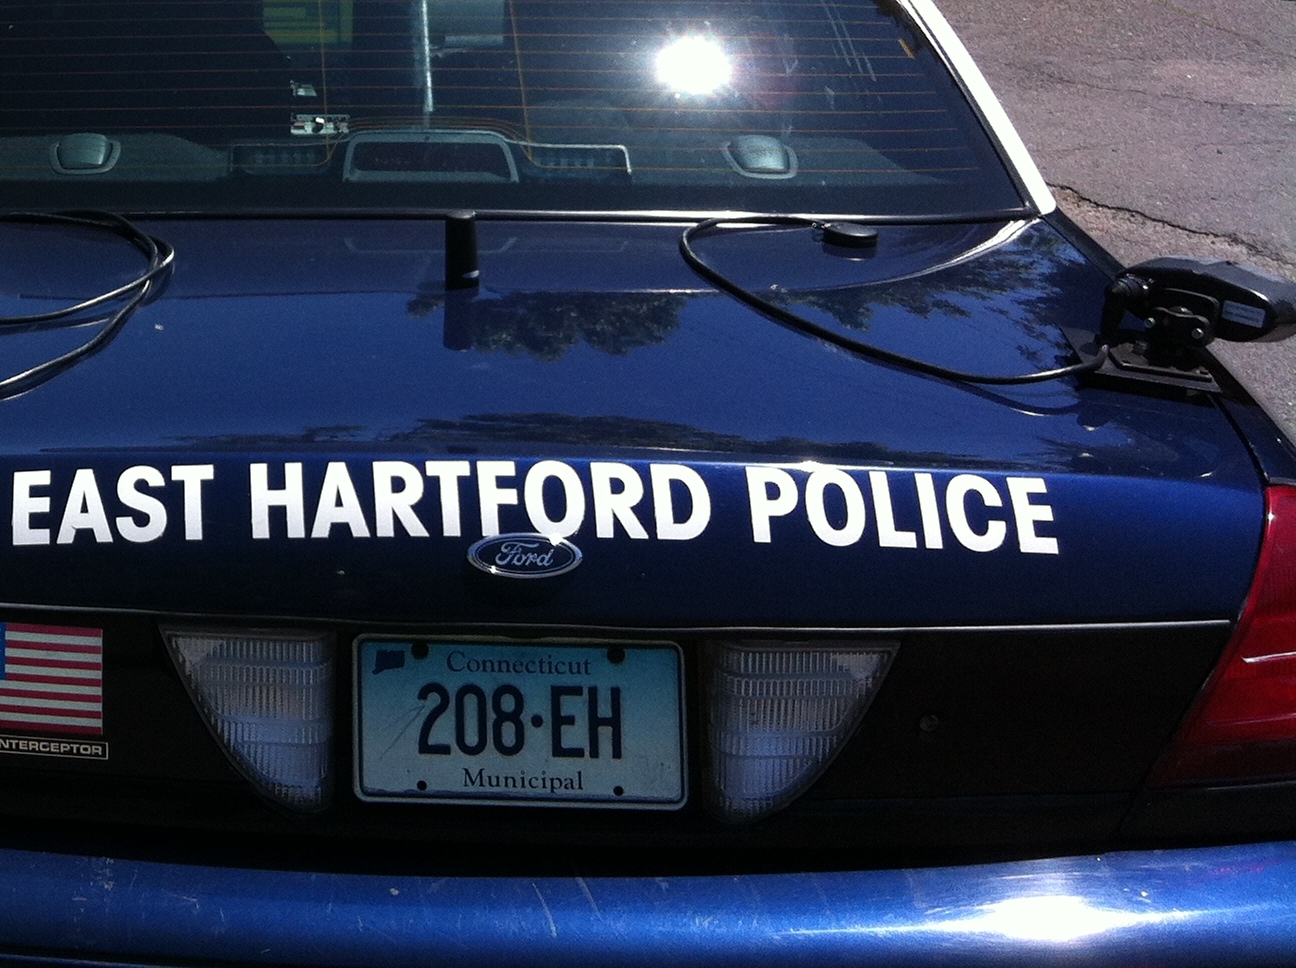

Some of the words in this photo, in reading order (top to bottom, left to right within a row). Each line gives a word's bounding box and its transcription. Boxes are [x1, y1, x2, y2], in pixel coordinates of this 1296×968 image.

[12, 464, 214, 546] EAST
[249, 459, 712, 541] HARTFORD
[745, 465, 1059, 555] POLICE
[494, 541, 554, 568] Ford
[446, 650, 592, 676] Connecticut
[462, 768, 584, 793] Municipal
